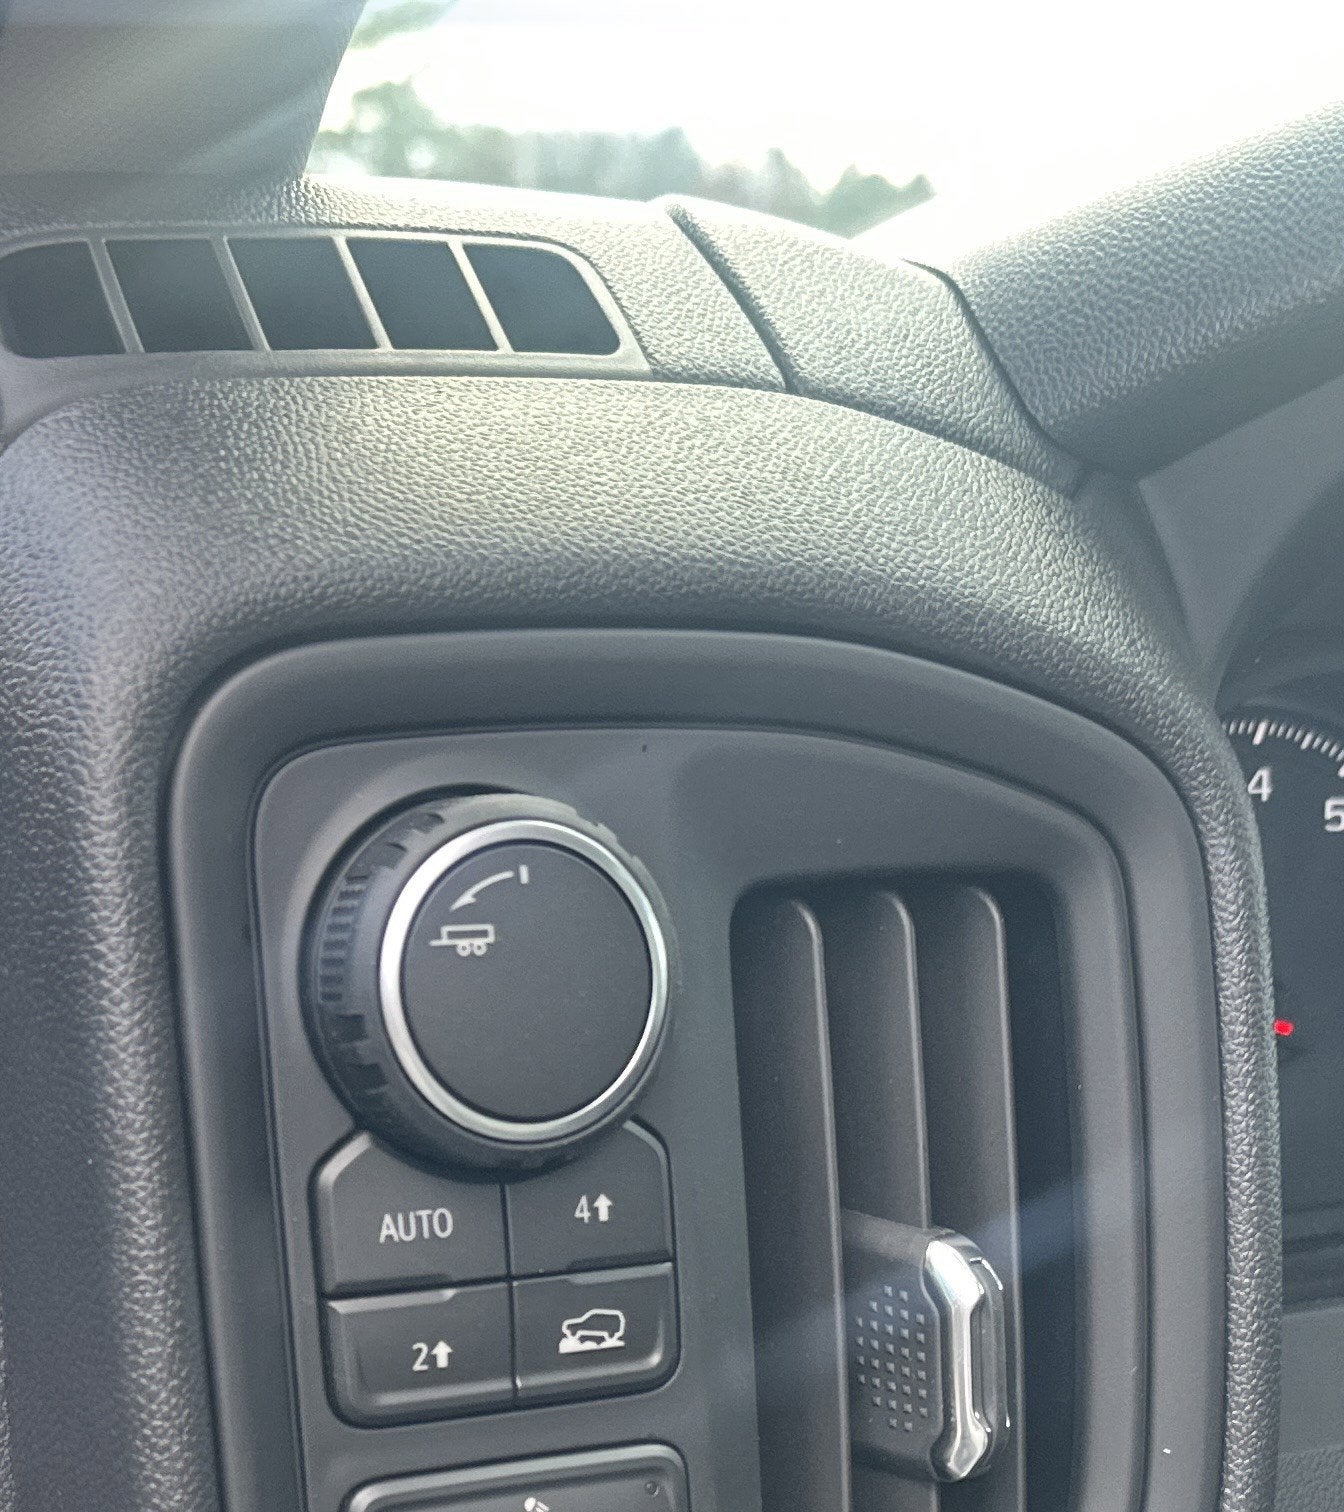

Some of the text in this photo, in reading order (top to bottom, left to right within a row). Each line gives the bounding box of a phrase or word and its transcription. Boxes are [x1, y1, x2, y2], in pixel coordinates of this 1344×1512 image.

[1247, 766, 1273, 802] 4
[379, 1207, 454, 1243] AUTO
[573, 1194, 591, 1224] 4
[411, 1342, 430, 1371] 2
